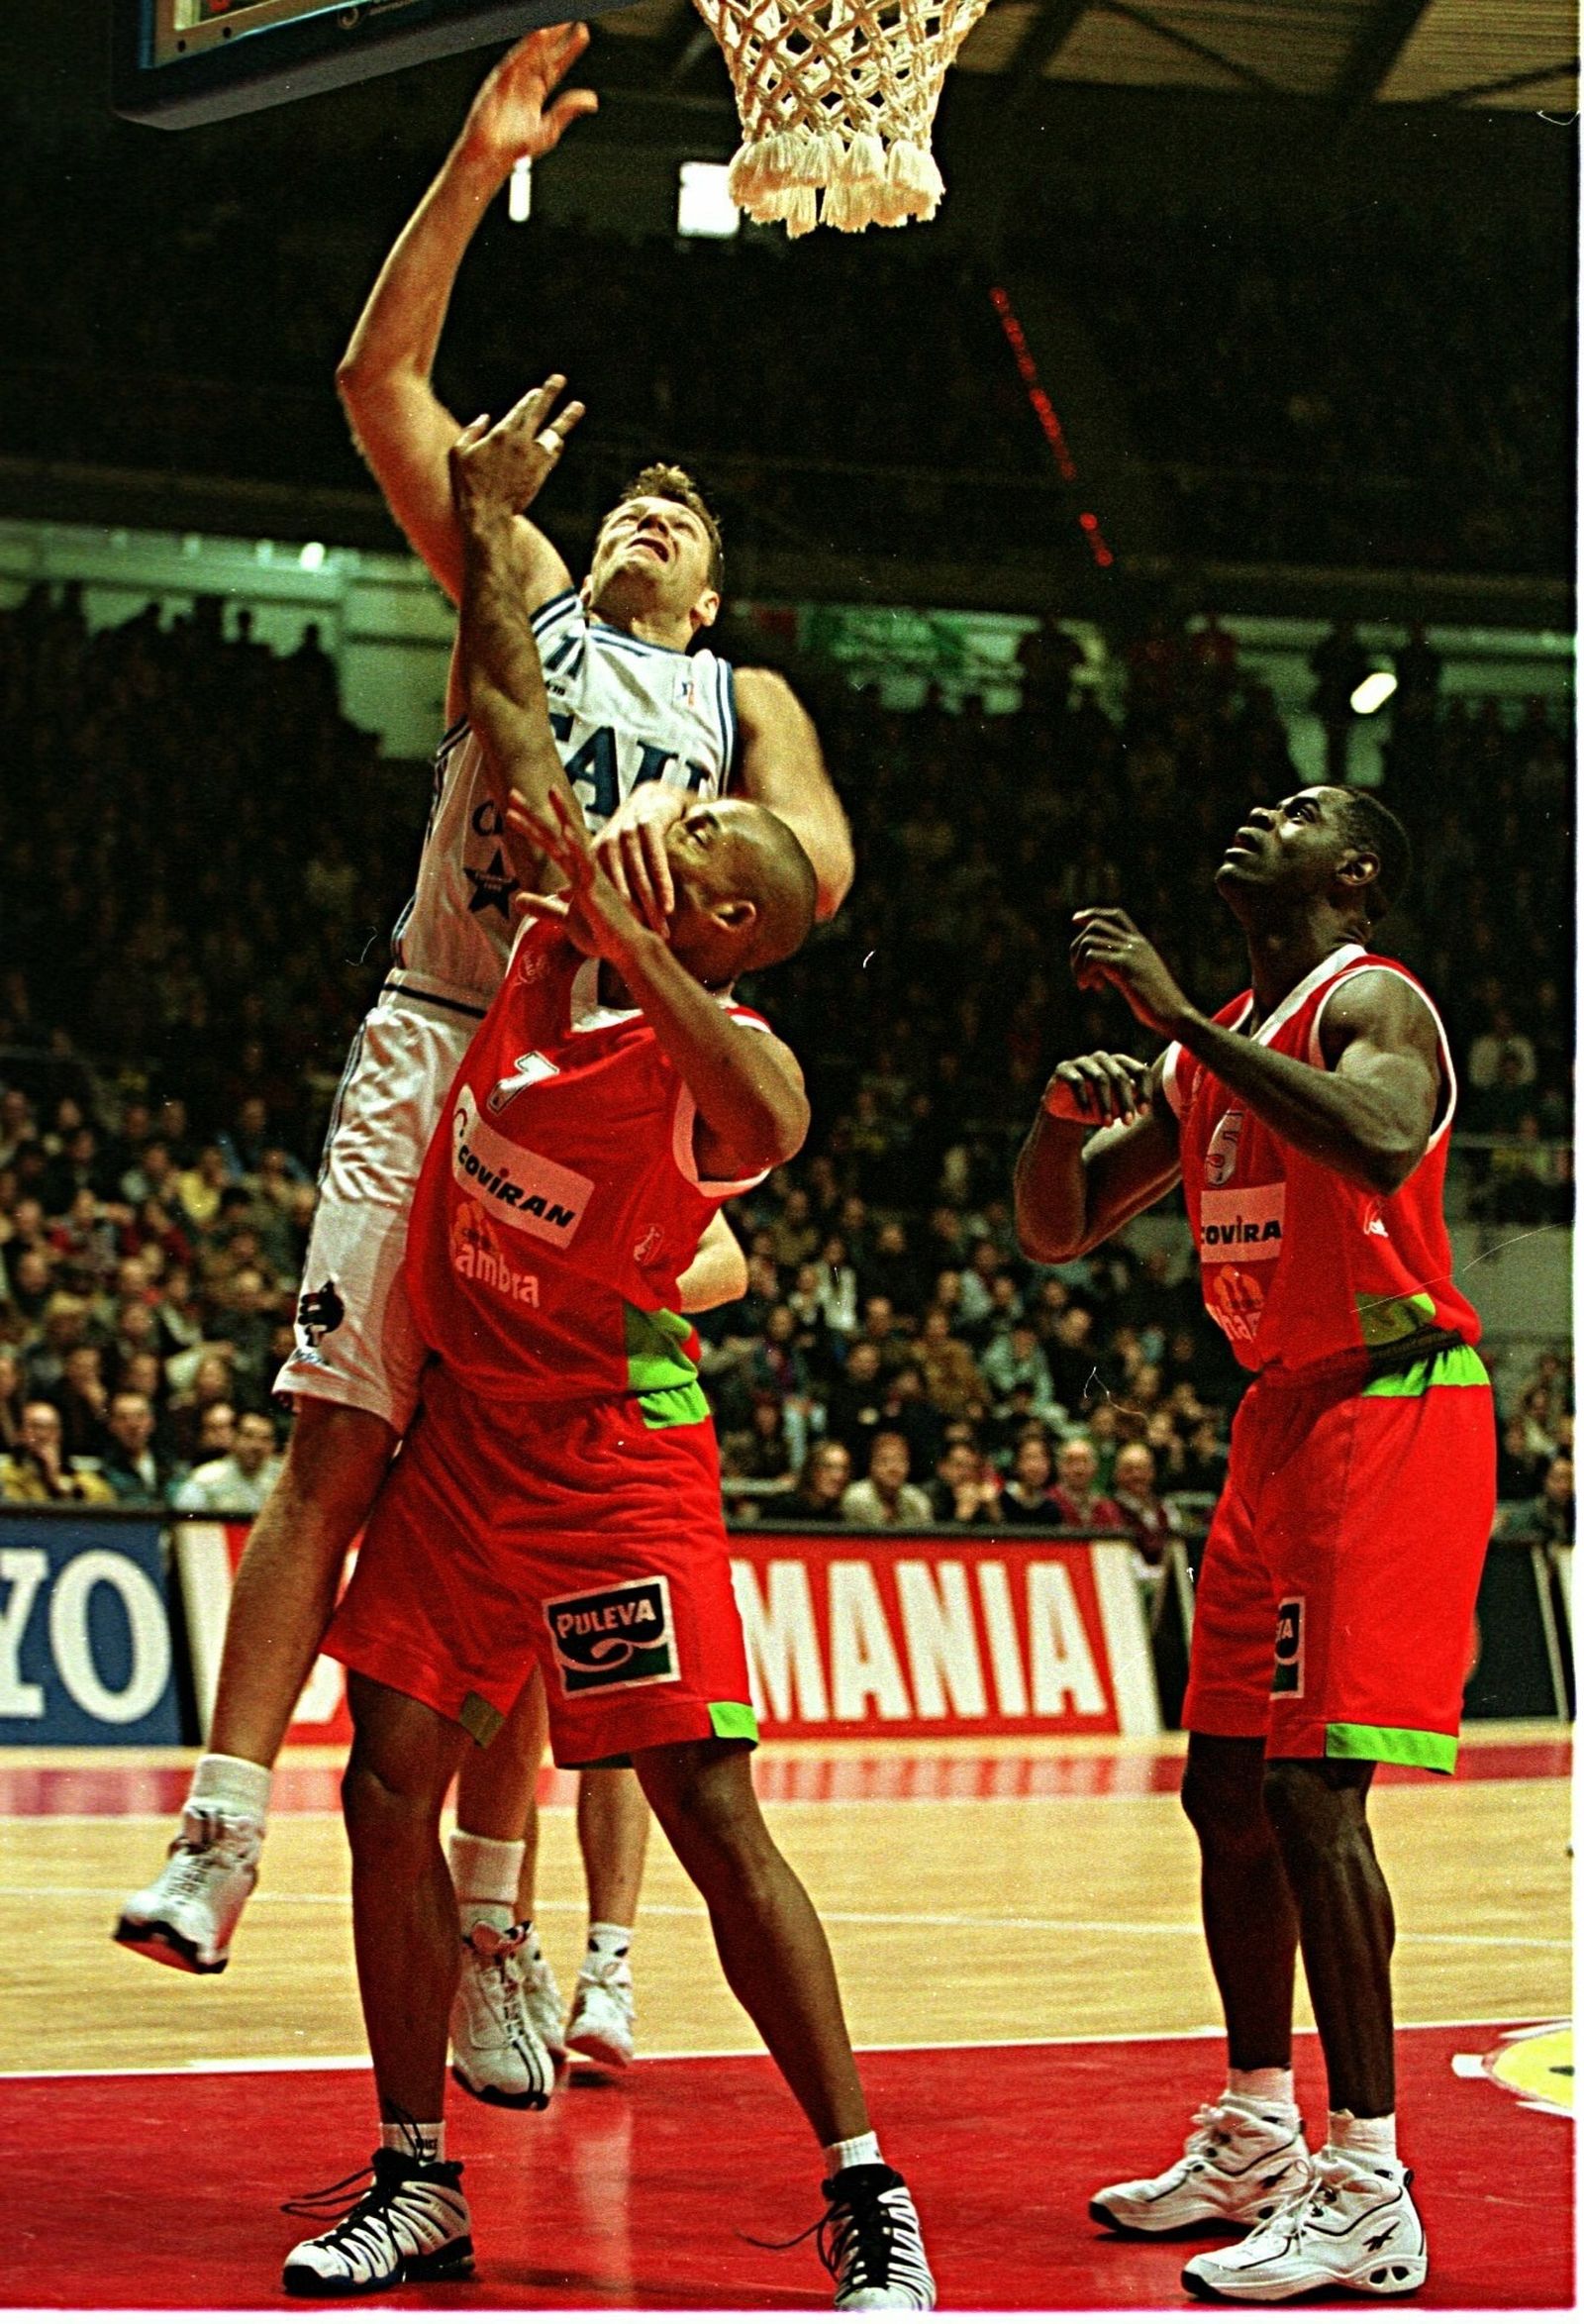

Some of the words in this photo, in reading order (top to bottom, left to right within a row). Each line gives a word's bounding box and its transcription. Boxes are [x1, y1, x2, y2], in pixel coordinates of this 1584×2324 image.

[0, 1547, 172, 1724] YO
[556, 1598, 656, 1639] PULEVA
[731, 1561, 1107, 1723] MANIA
